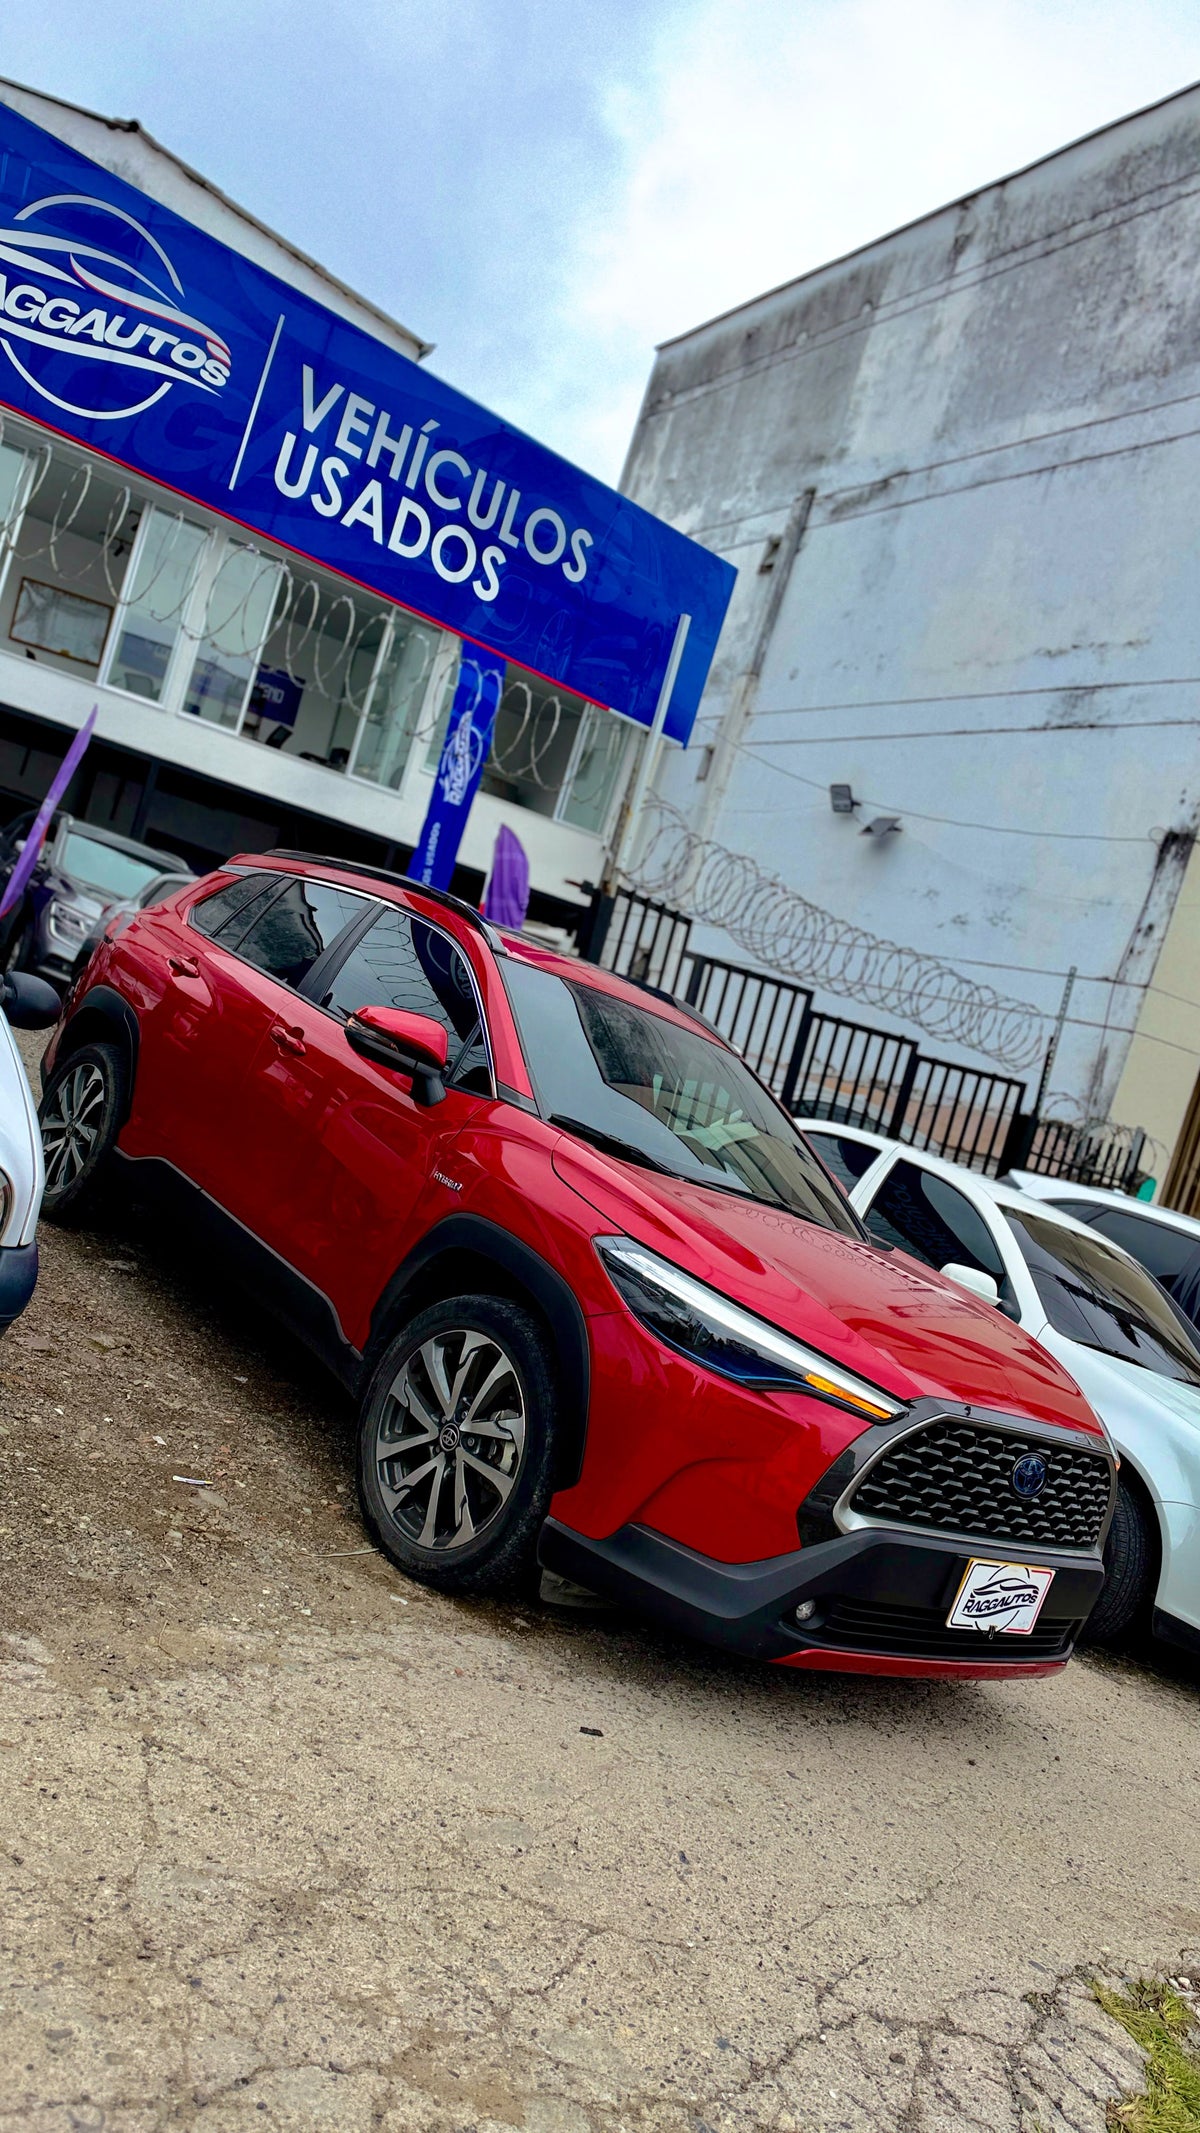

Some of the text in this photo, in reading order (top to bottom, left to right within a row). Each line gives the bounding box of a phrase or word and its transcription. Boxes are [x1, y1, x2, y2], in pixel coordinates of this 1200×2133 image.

[0, 274, 231, 387] GGAUTOS
[273, 430, 507, 602] USADOS
[302, 363, 595, 583] VEHÍCULOS
[962, 1593, 1038, 1613] RAGGAUTOS
